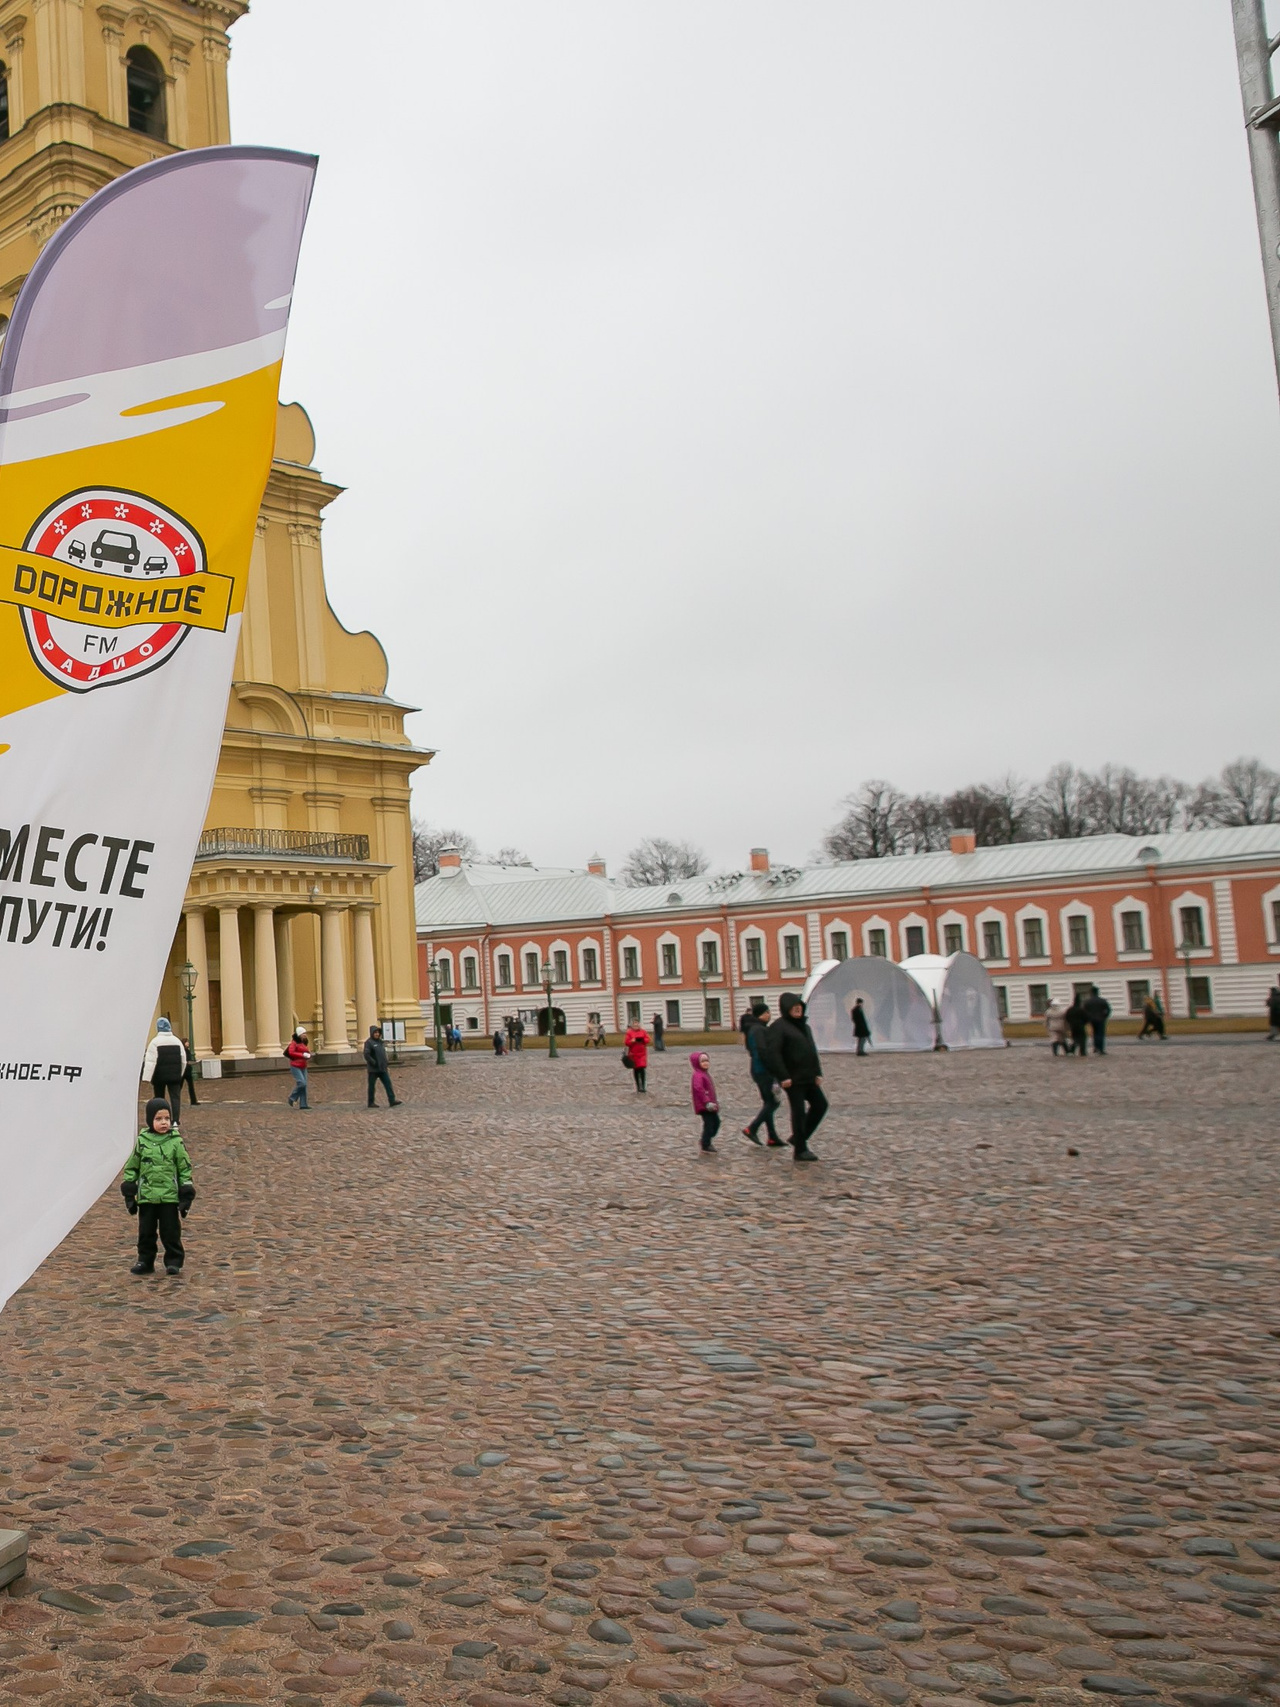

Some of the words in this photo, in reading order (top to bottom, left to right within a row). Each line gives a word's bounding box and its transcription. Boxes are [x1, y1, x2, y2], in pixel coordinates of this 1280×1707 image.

[14, 564, 206, 617] ДОРОЖНОЕ
[42, 638, 153, 680] РАДИО
[83, 634, 118, 655] FM
